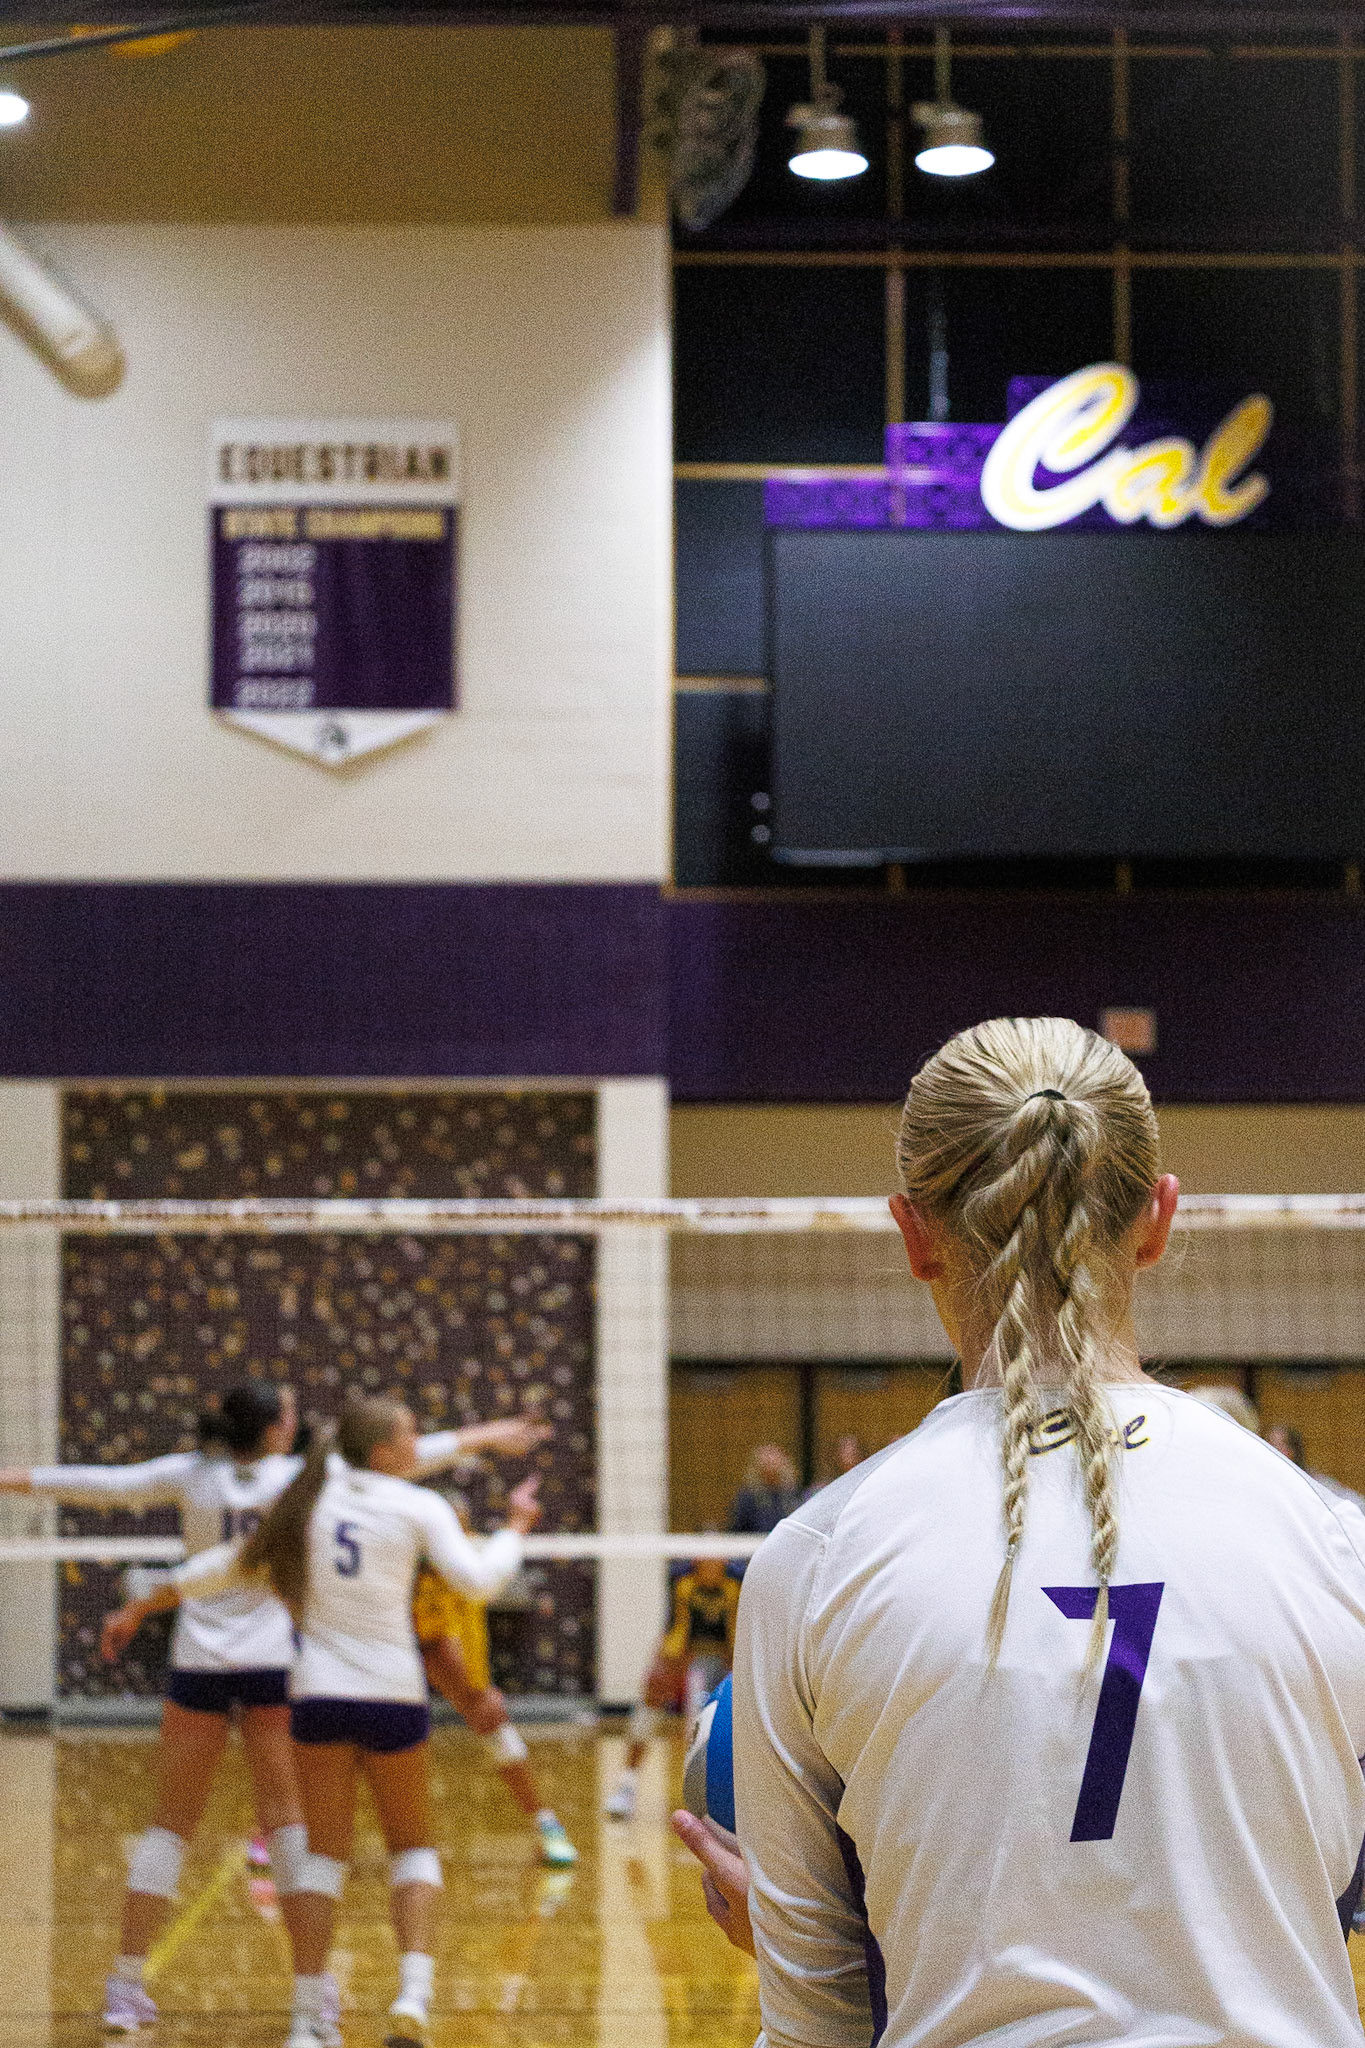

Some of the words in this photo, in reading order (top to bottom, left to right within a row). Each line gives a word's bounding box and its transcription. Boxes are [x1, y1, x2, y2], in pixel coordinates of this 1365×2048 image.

[980, 361, 1274, 531] Cal
[333, 1519, 361, 1579] 5
[1040, 1582, 1165, 1843] 7
